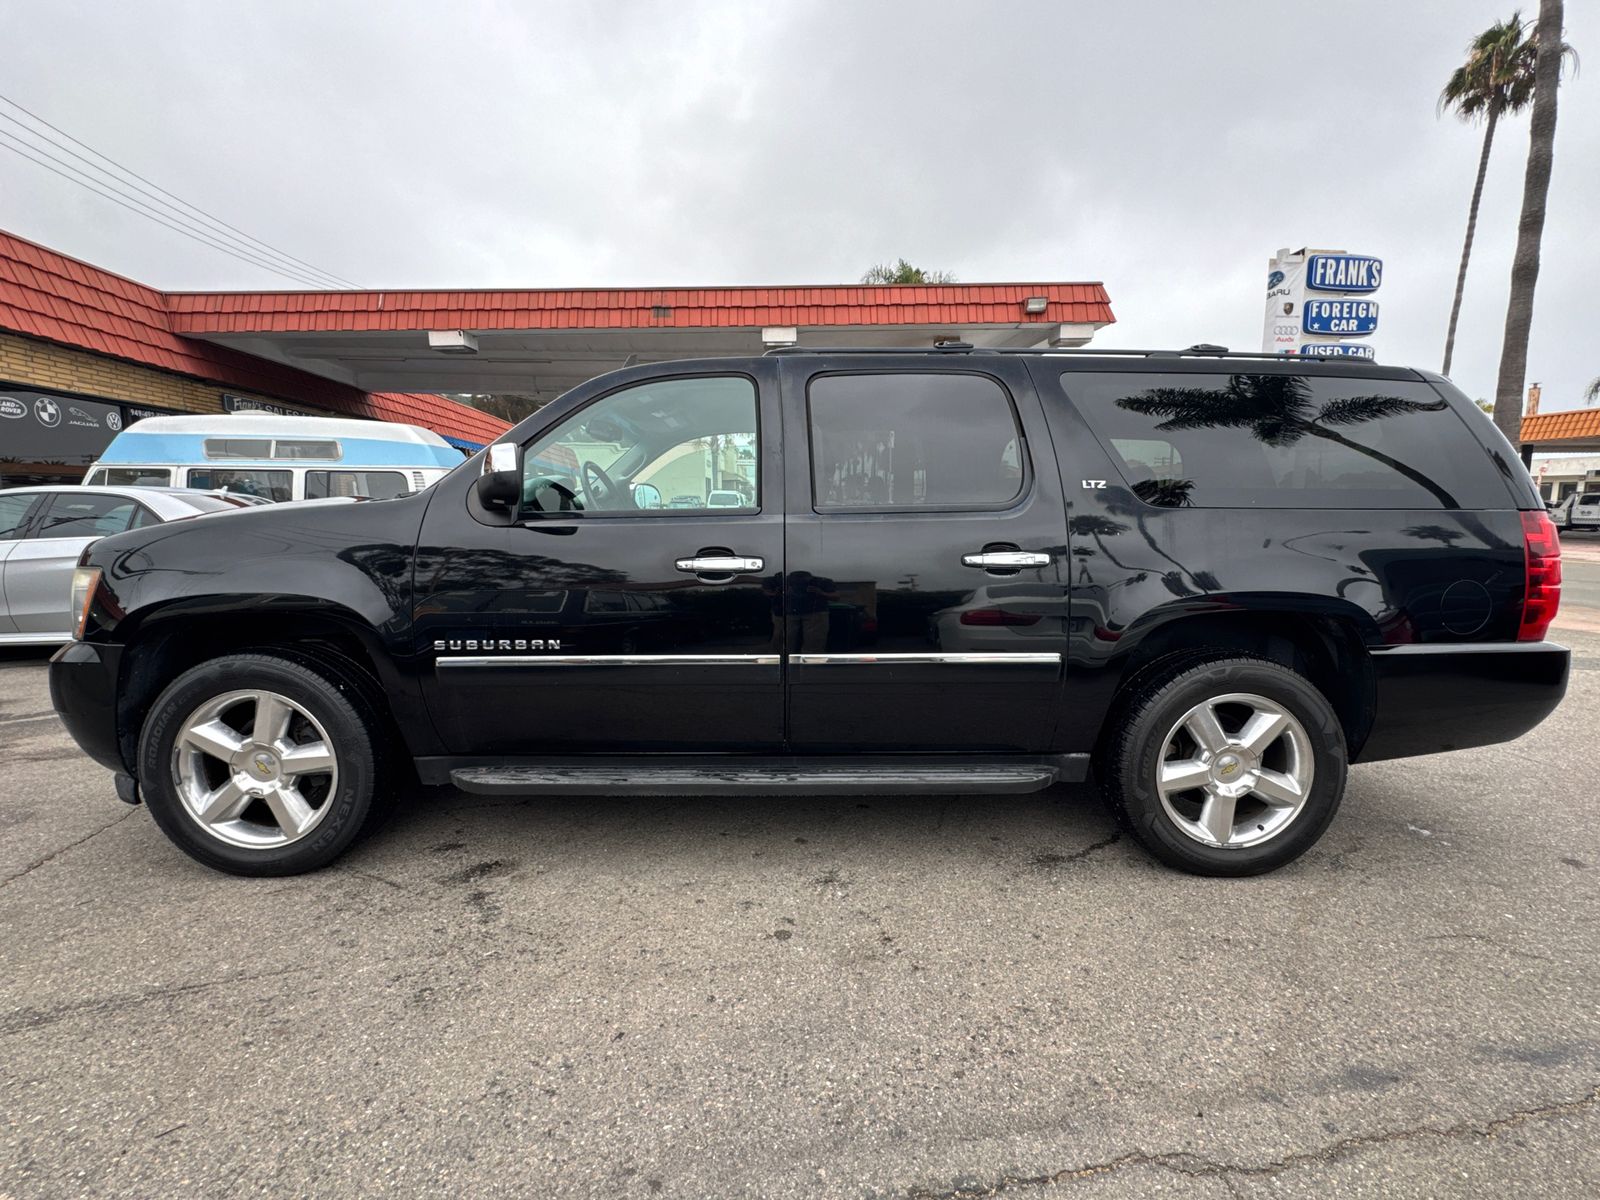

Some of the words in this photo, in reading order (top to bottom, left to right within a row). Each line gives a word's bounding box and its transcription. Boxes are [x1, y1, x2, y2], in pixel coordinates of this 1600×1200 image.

[1315, 258, 1381, 287] FRANK'S
[1311, 302, 1377, 318] FOREIGN
[1330, 319, 1358, 331] CAR
[1309, 346, 1343, 356] USED
[1348, 346, 1374, 359] CAR
[0, 406, 21, 414] ROVER
[69, 420, 100, 428] JAGUAR
[1082, 480, 1107, 489] LTZ
[434, 639, 561, 650] SUBURBAN
[311, 788, 354, 851] NEXEN
